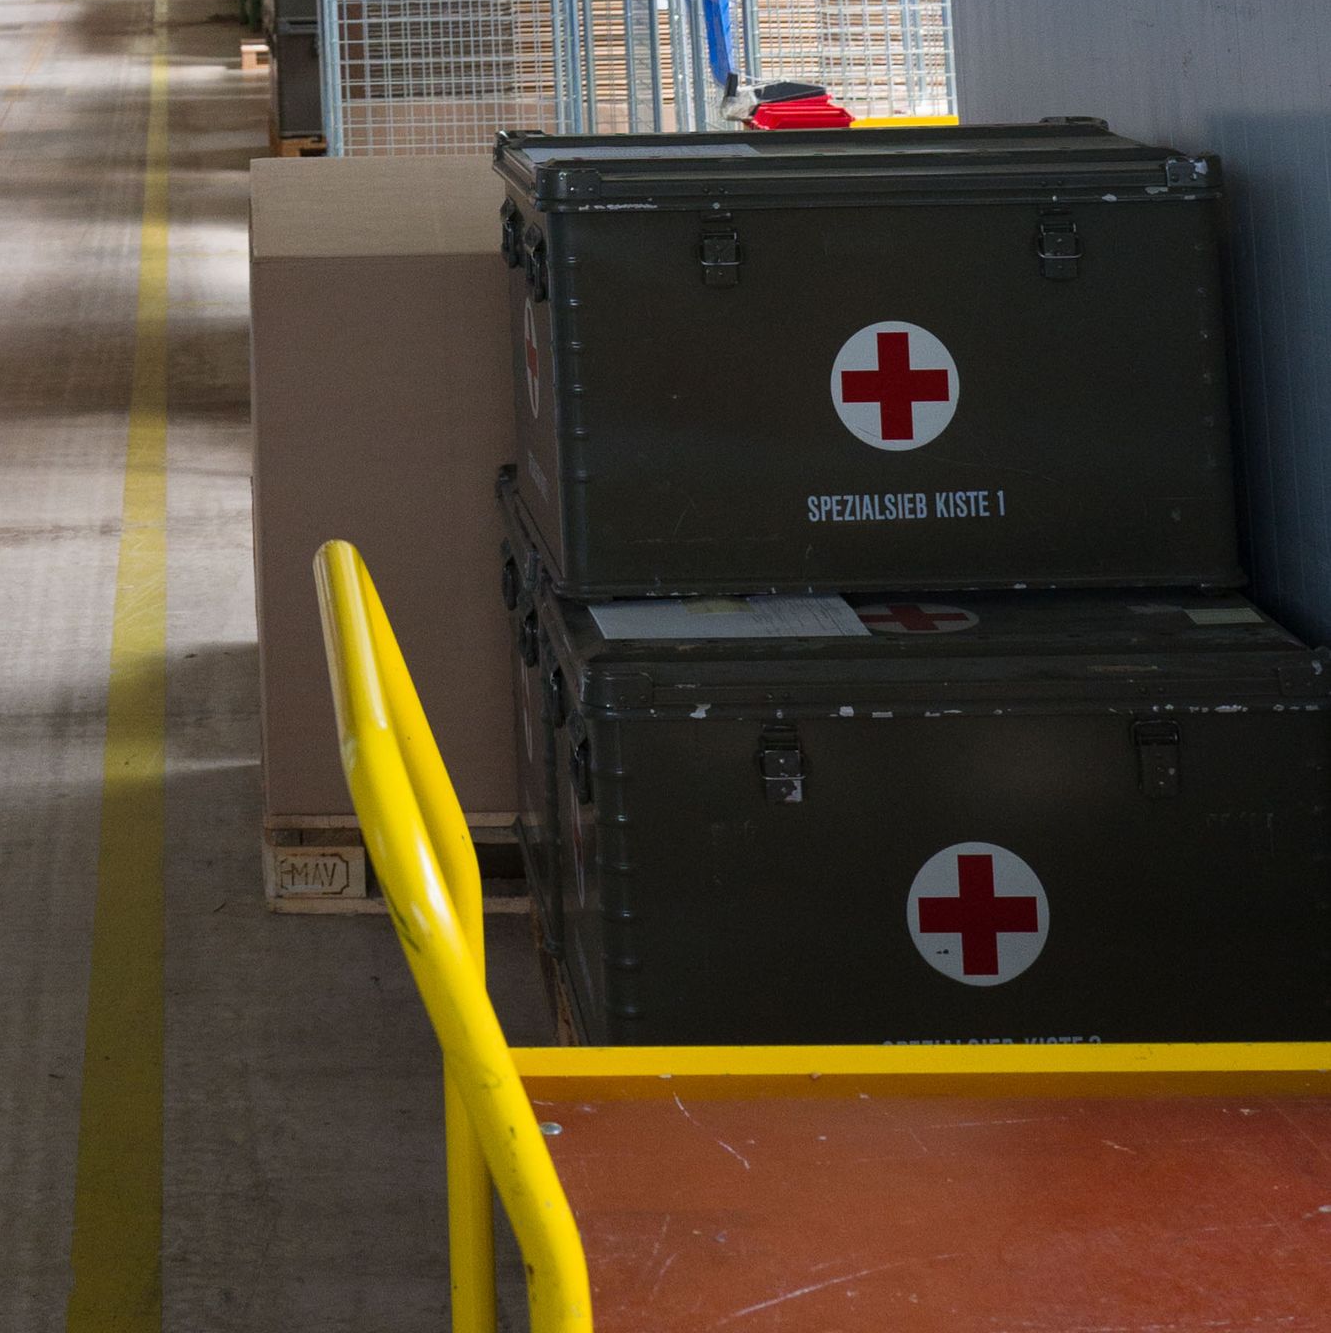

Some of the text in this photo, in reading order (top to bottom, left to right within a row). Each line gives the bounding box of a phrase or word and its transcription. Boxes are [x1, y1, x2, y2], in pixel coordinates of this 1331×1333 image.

[807, 489, 1006, 522] SPEZIALSIEB KISTE 1
